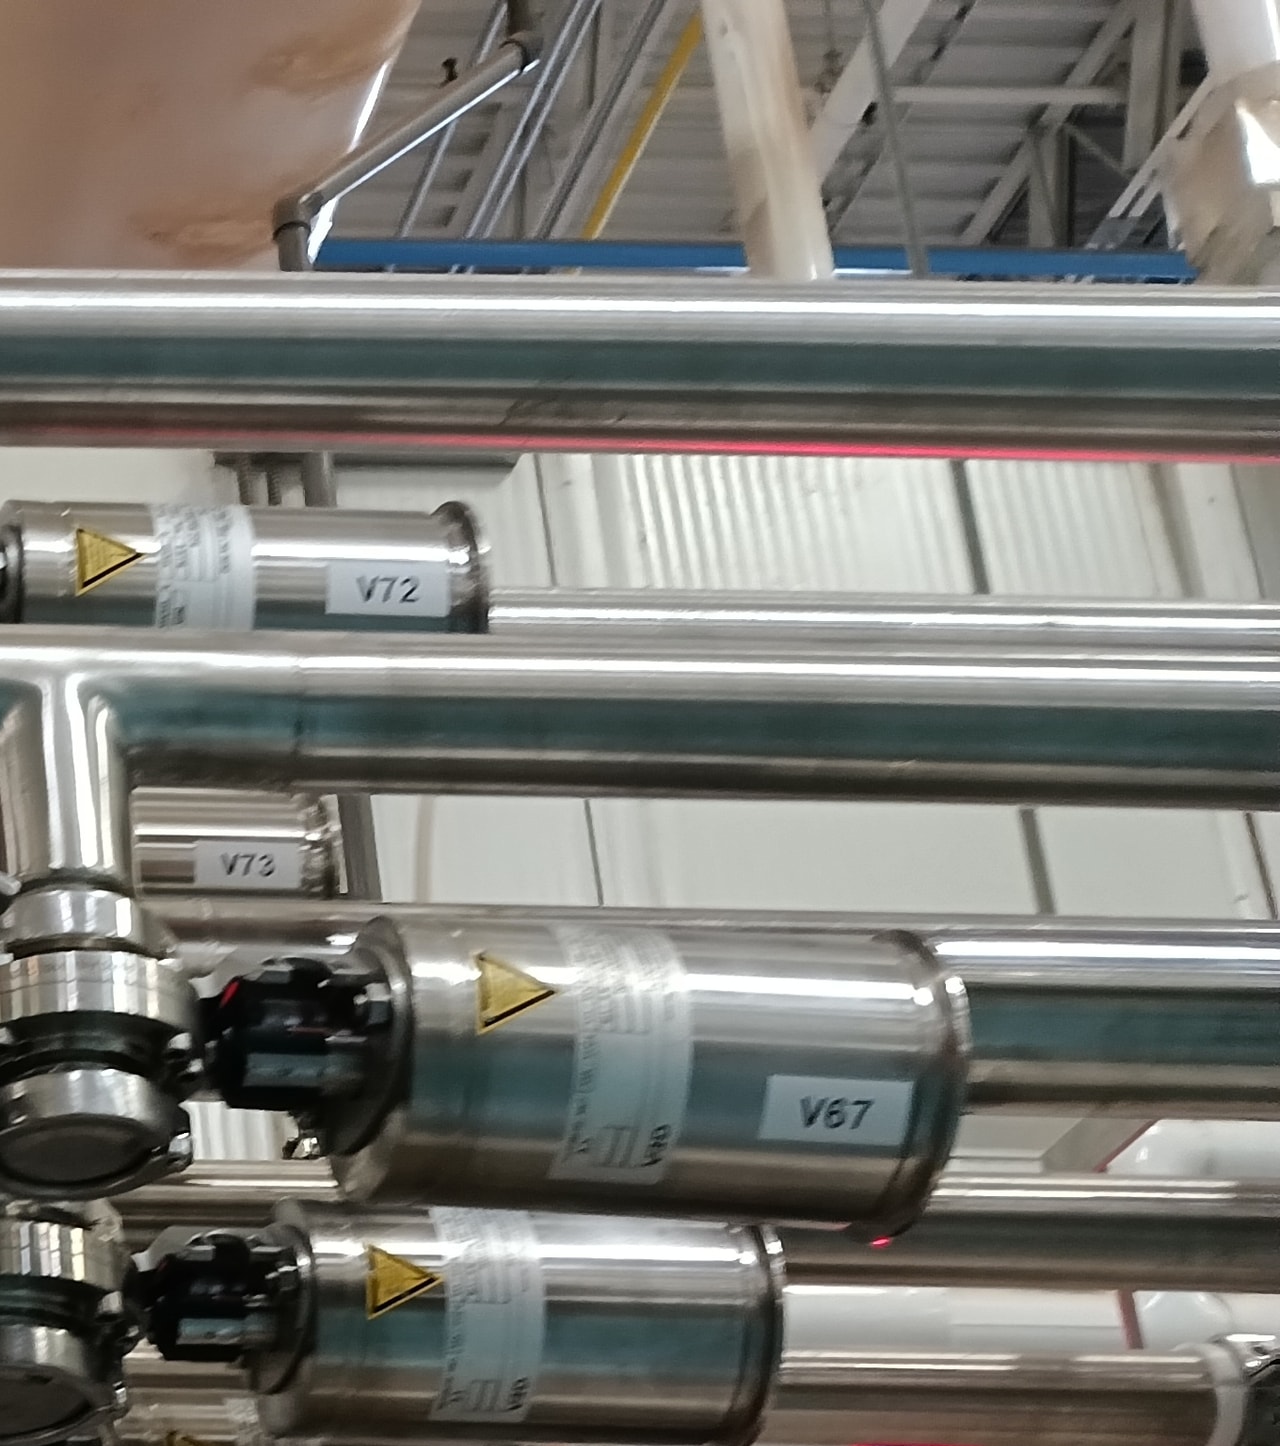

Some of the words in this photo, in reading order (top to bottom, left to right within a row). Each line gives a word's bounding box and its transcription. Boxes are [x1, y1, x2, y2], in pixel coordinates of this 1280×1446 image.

[356, 575, 422, 604] V72
[220, 853, 277, 878] V73
[799, 1096, 876, 1130] V67
